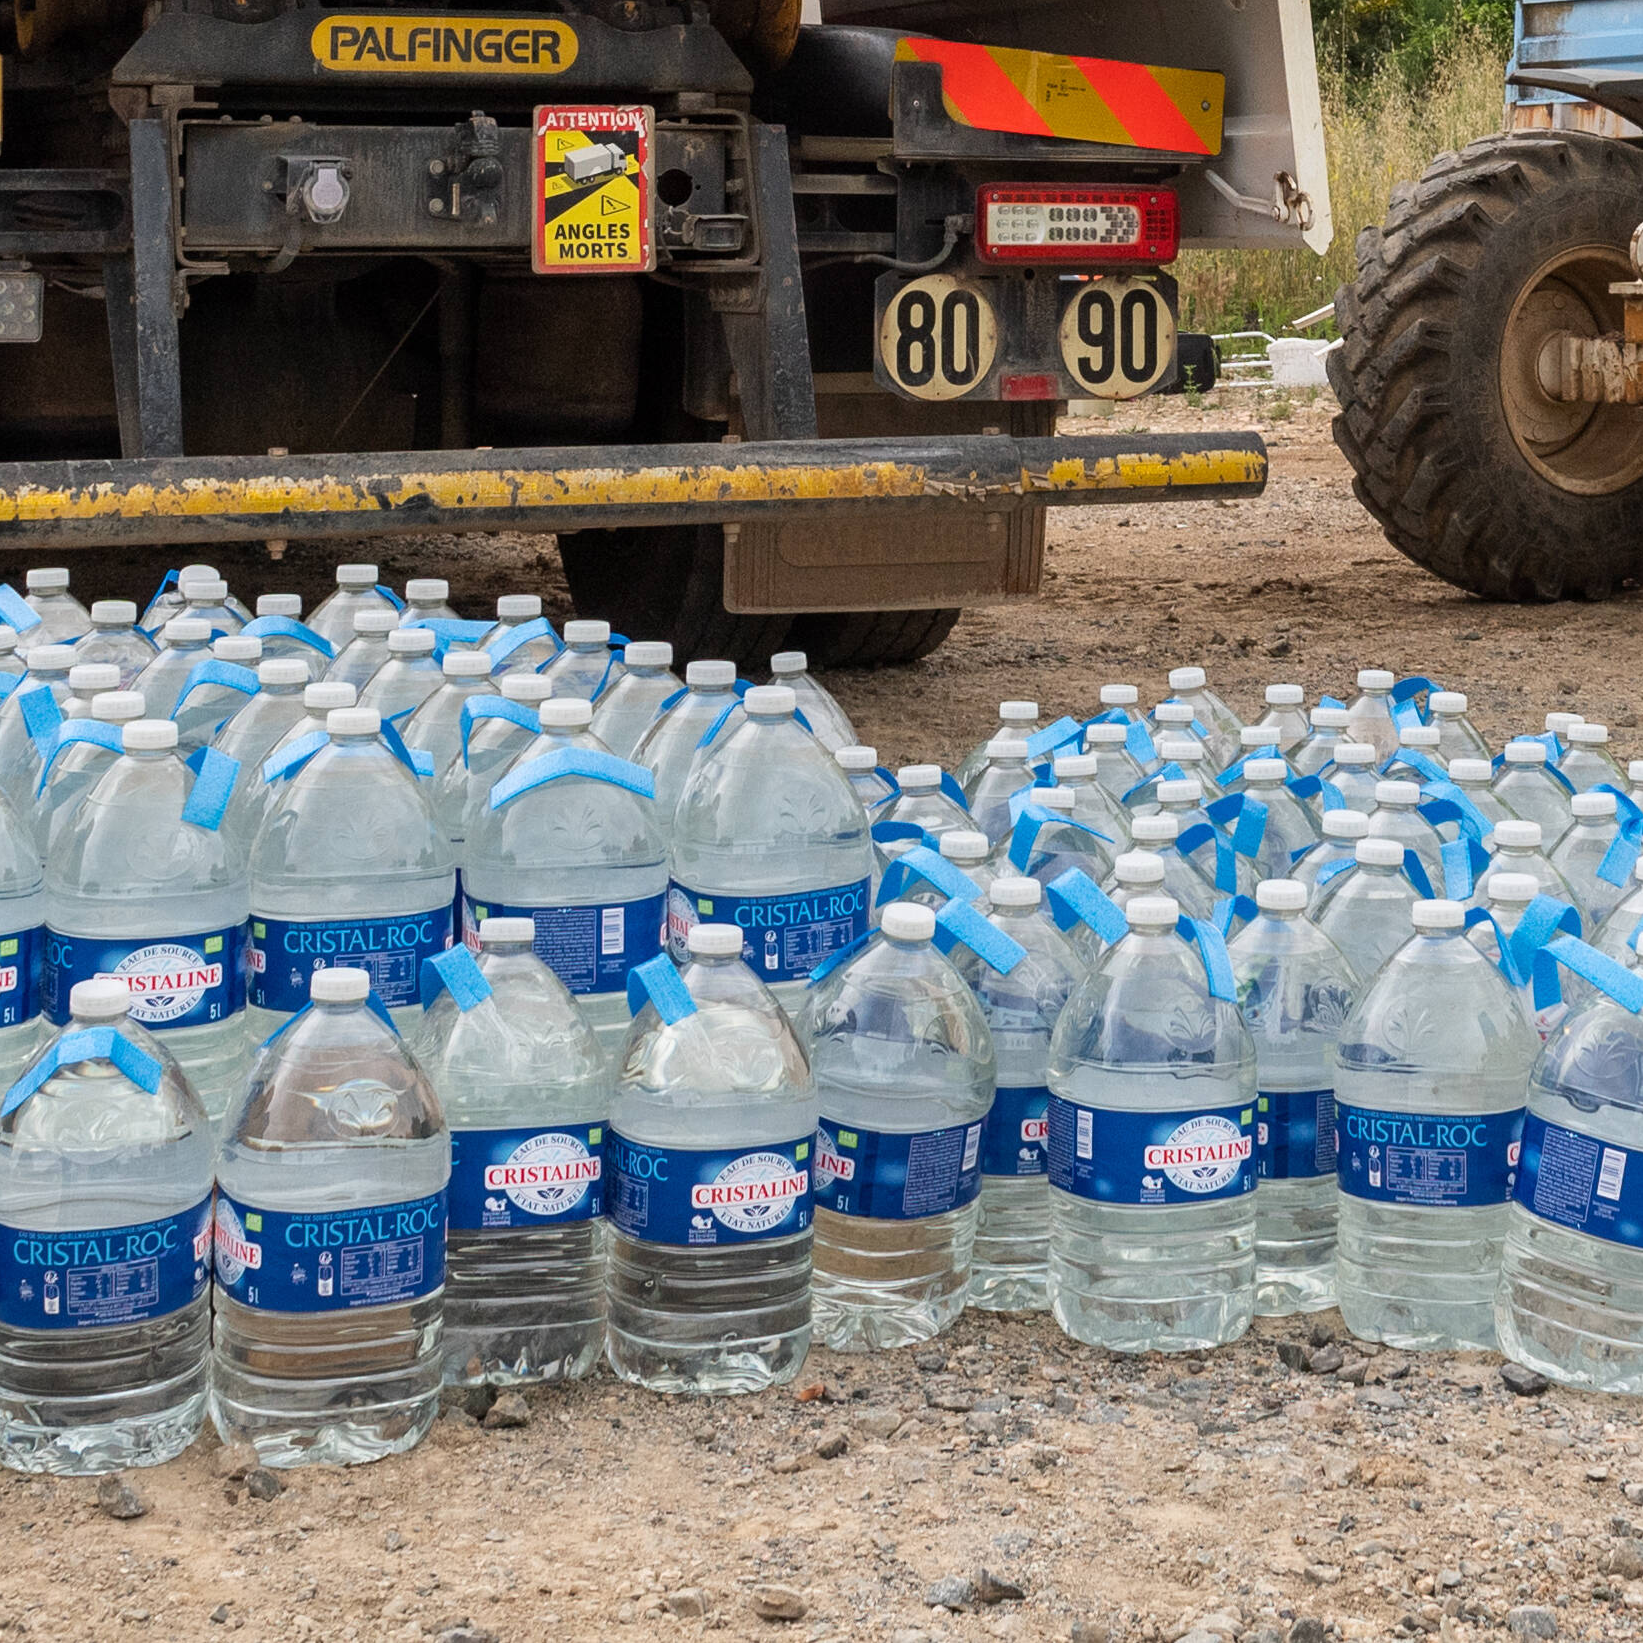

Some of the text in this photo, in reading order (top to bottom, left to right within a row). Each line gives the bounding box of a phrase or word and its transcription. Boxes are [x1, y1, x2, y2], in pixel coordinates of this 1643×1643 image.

[330, 25, 561, 65] PALFINGER
[546, 111, 640, 127] ATTENTION
[554, 223, 630, 240] ANGLES
[559, 242, 628, 259] MORTS
[896, 289, 980, 387] 80
[1077, 288, 1157, 384] 90
[734, 889, 863, 928] CRISTAL-ROC
[284, 921, 433, 954] CRISTAL-ROC
[100, 966, 220, 994] ISTALINE
[129, 1006, 155, 1020] TAT
[1347, 1115, 1487, 1148] CRISTAL-ROC
[1148, 1139, 1251, 1165] CRISTALINE
[488, 1159, 600, 1186] CRISTALINE
[694, 1174, 807, 1205] CRISTALINE
[285, 1203, 439, 1248] CRISTAL-ROC
[13, 1225, 178, 1266] CRISTAL-ROC
